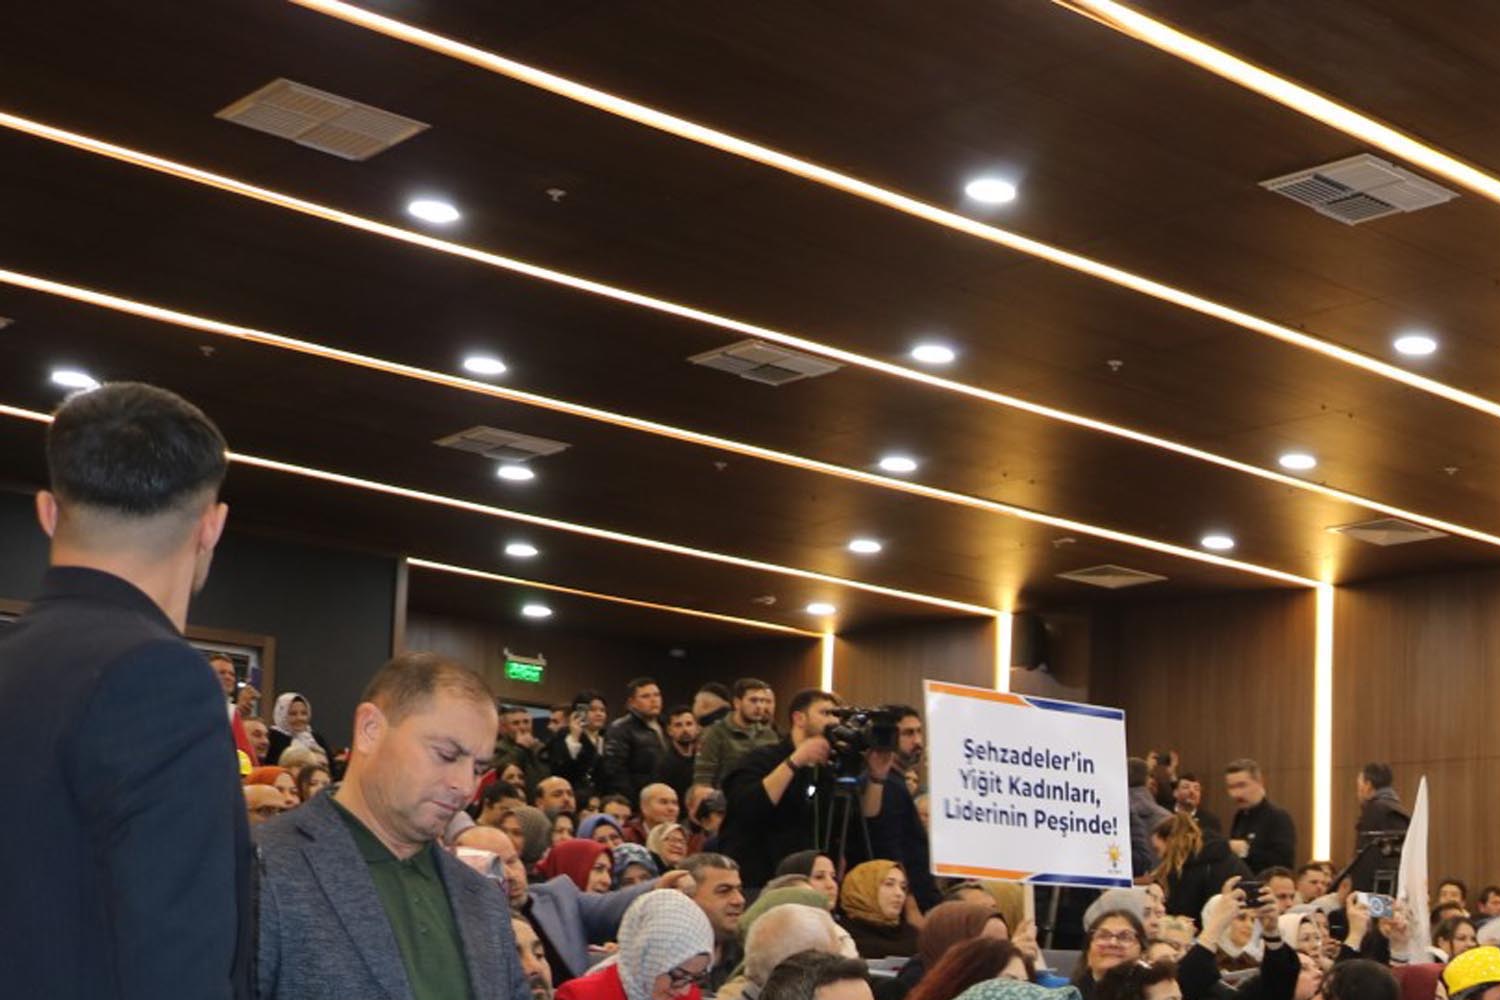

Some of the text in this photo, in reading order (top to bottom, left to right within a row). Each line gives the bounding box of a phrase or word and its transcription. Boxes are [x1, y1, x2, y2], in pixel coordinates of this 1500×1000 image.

[963, 738, 1095, 774] Şehzadeler'in
[959, 769, 1101, 808] Yiğit Kadınları,
[944, 798, 1118, 837] Liderinin Peşinde!
